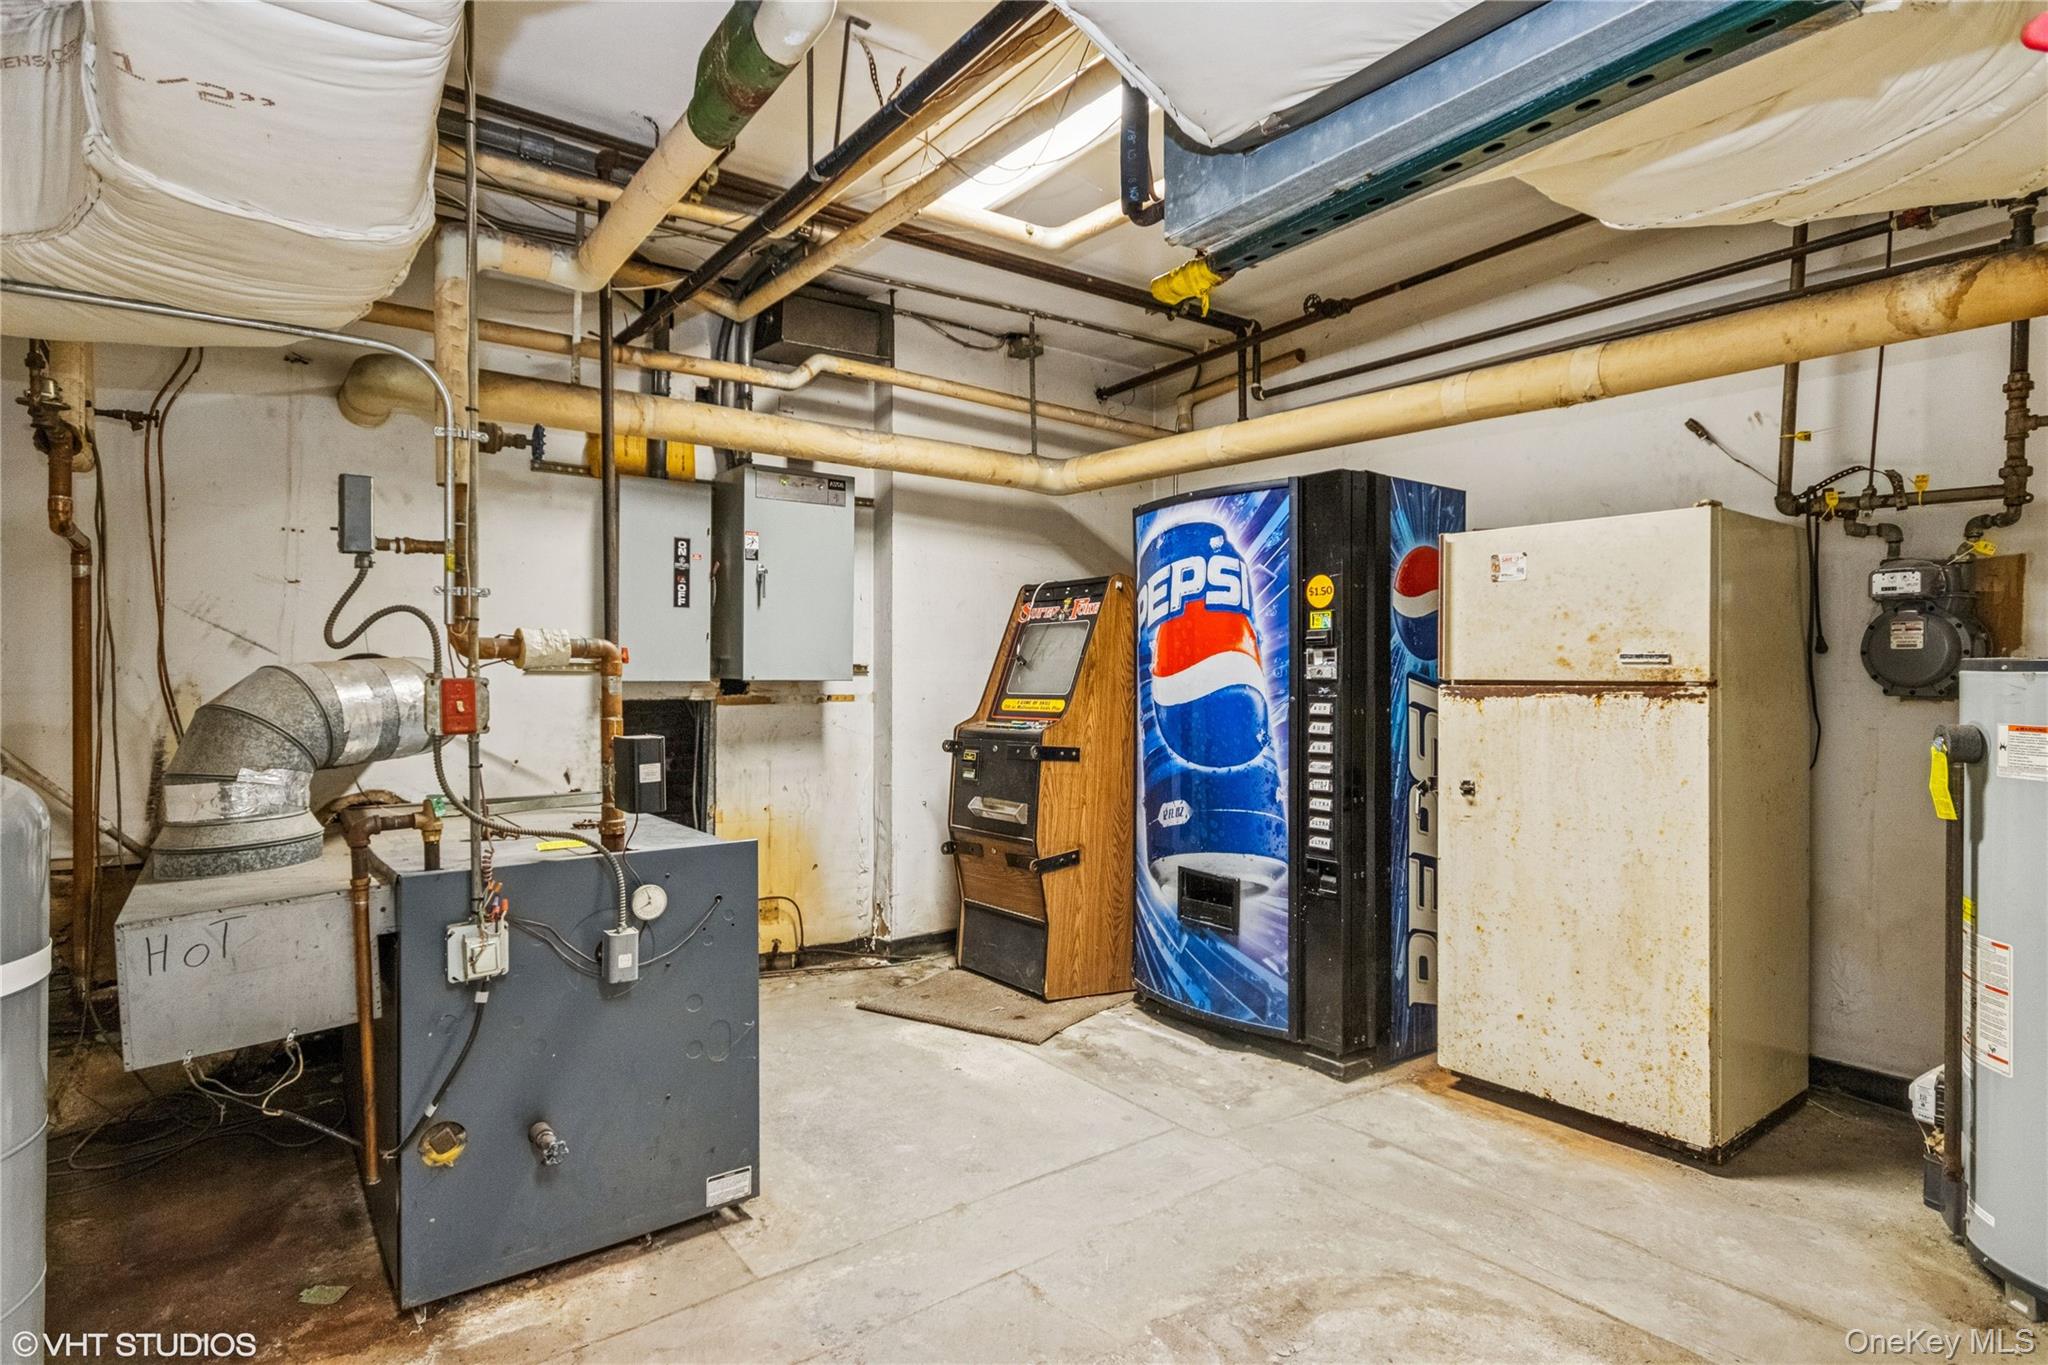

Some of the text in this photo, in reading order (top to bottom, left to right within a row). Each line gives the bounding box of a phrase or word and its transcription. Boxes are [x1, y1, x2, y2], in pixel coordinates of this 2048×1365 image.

[677, 540, 687, 556] ON
[677, 584, 687, 606] OFF
[1137, 555, 1251, 629] PEPSI
[1308, 585, 1333, 597] $1.50
